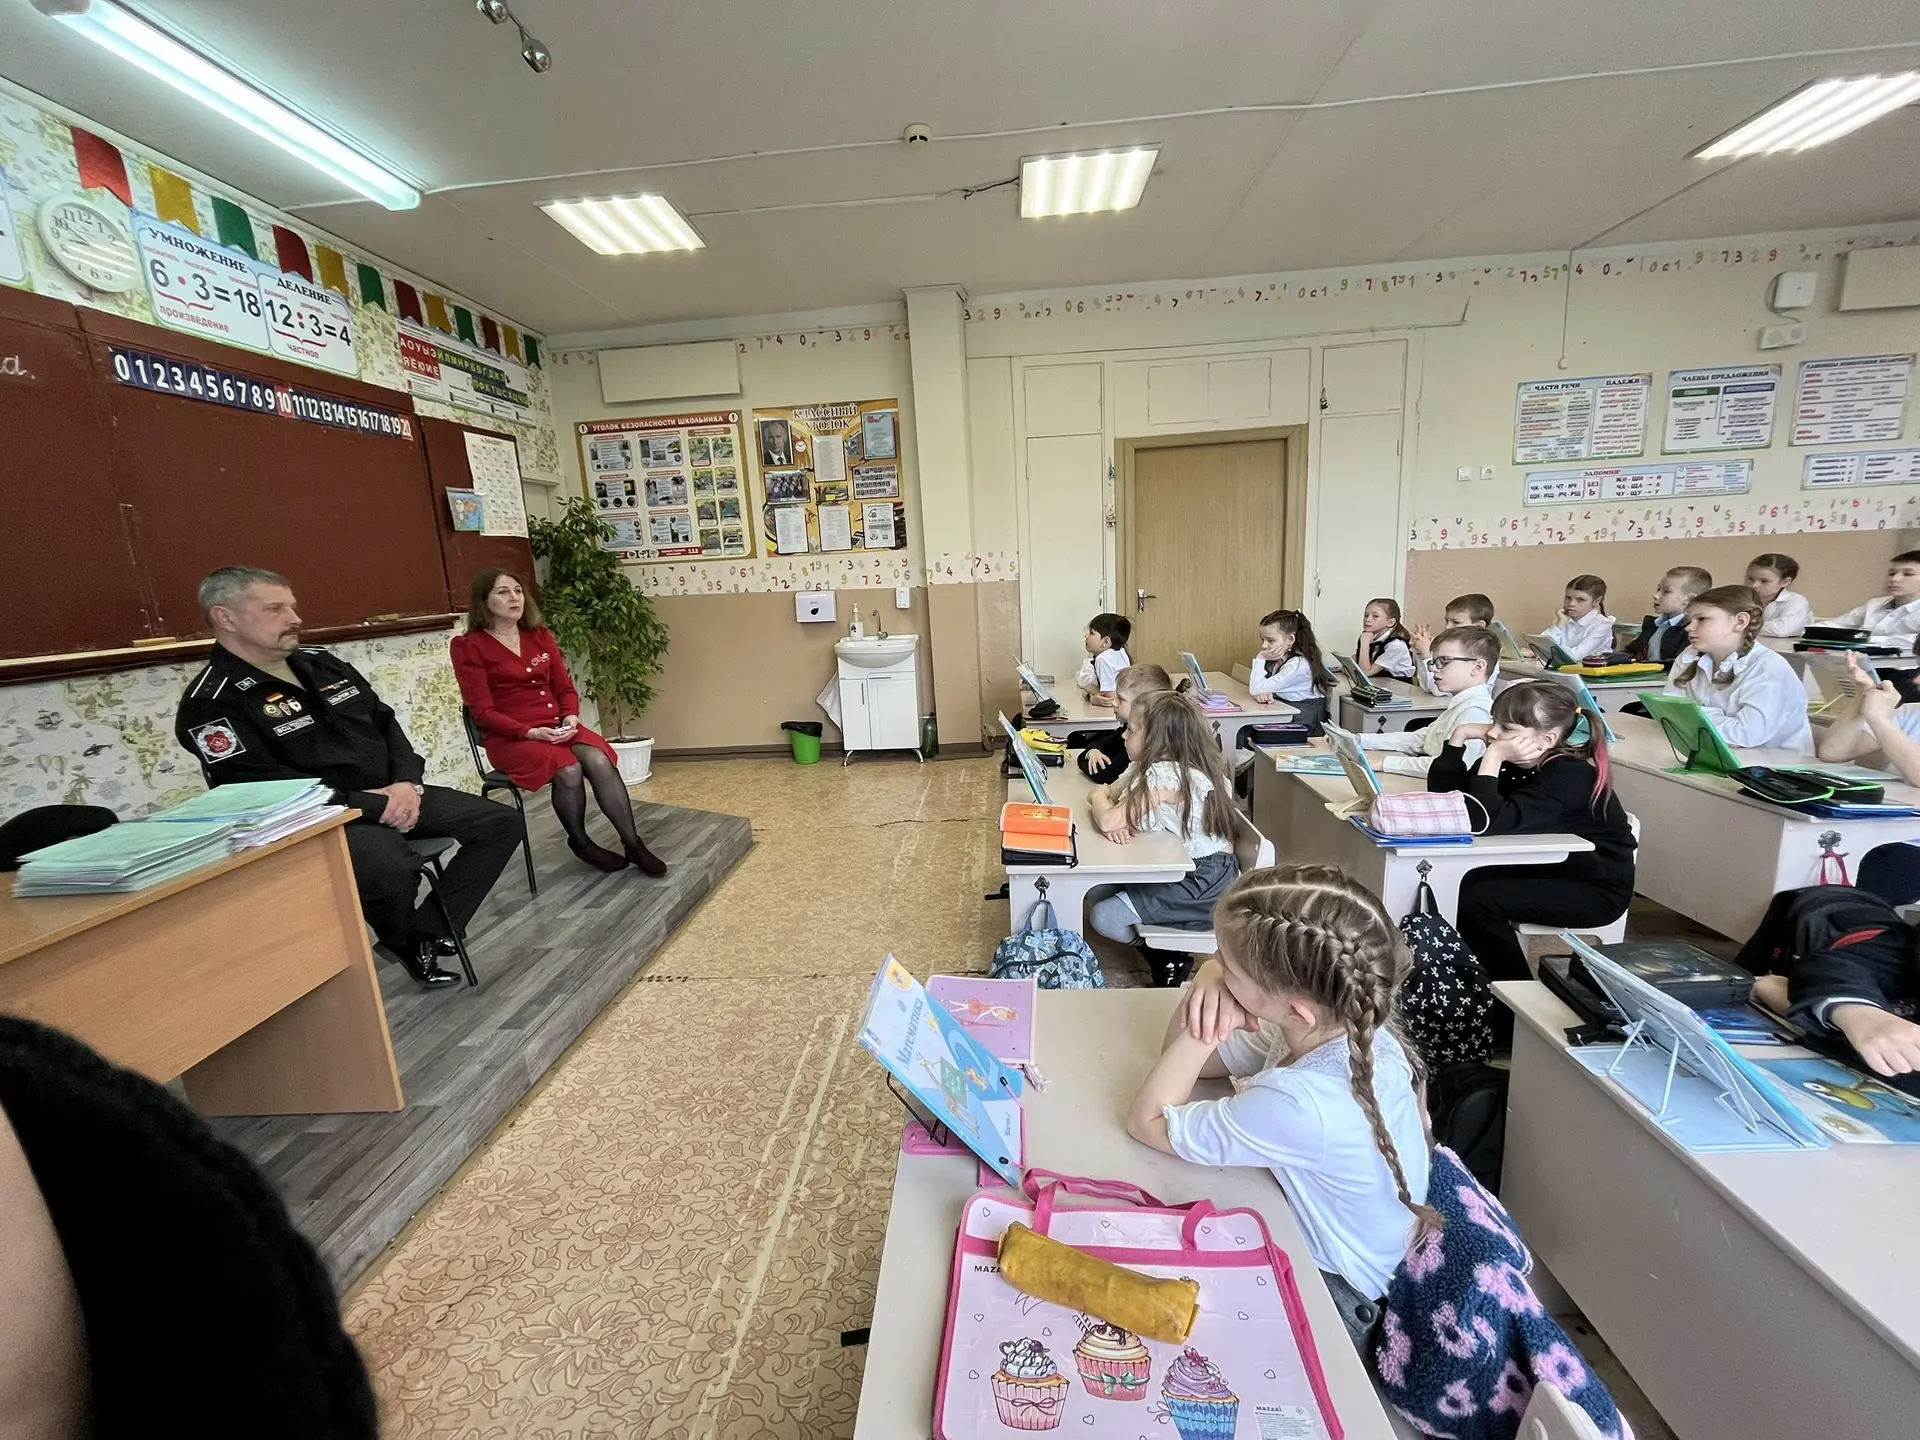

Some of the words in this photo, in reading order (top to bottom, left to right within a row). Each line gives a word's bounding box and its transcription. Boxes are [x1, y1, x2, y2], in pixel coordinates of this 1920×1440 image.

[148, 227, 247, 273] УМНОЖЕНИЕ
[277, 277, 332, 305] ДЕЛЕНИЕ
[160, 305, 230, 332] произведение
[287, 343, 319, 359] частное
[1710, 371, 1769, 380] ПРЕДЛОЖЕНИЯ
[114, 354, 130, 381] 0
[135, 359, 148, 384] 1
[153, 363, 169, 388] 2
[171, 366, 186, 391] 3
[189, 371, 203, 395] 4
[206, 375, 219, 398] 5
[222, 379, 234, 401] 6
[236, 381, 246, 403] 7
[251, 385, 263, 407] 8
[264, 388, 276, 409] 9
[276, 391, 291, 413] 10
[292, 394, 306, 416] 11
[305, 397, 320, 419] 12
[320, 401, 333, 421] 13
[332, 404, 345, 424] 14
[345, 406, 357, 426] 15
[358, 409, 369, 429] 16
[369, 412, 379, 430] 17
[380, 414, 391, 433] 18
[391, 416, 400, 435] 19
[400, 418, 412, 437] 20
[793, 404, 858, 420] КЛАССНЫЙ
[592, 424, 620, 432] УГОЛОК
[621, 420, 676, 430] БЕЗОПАСНОСТИ
[678, 415, 724, 425] ШКОЛЬНИКА
[804, 420, 851, 431] УГОЛОК
[897, 997, 923, 1070] Математика
